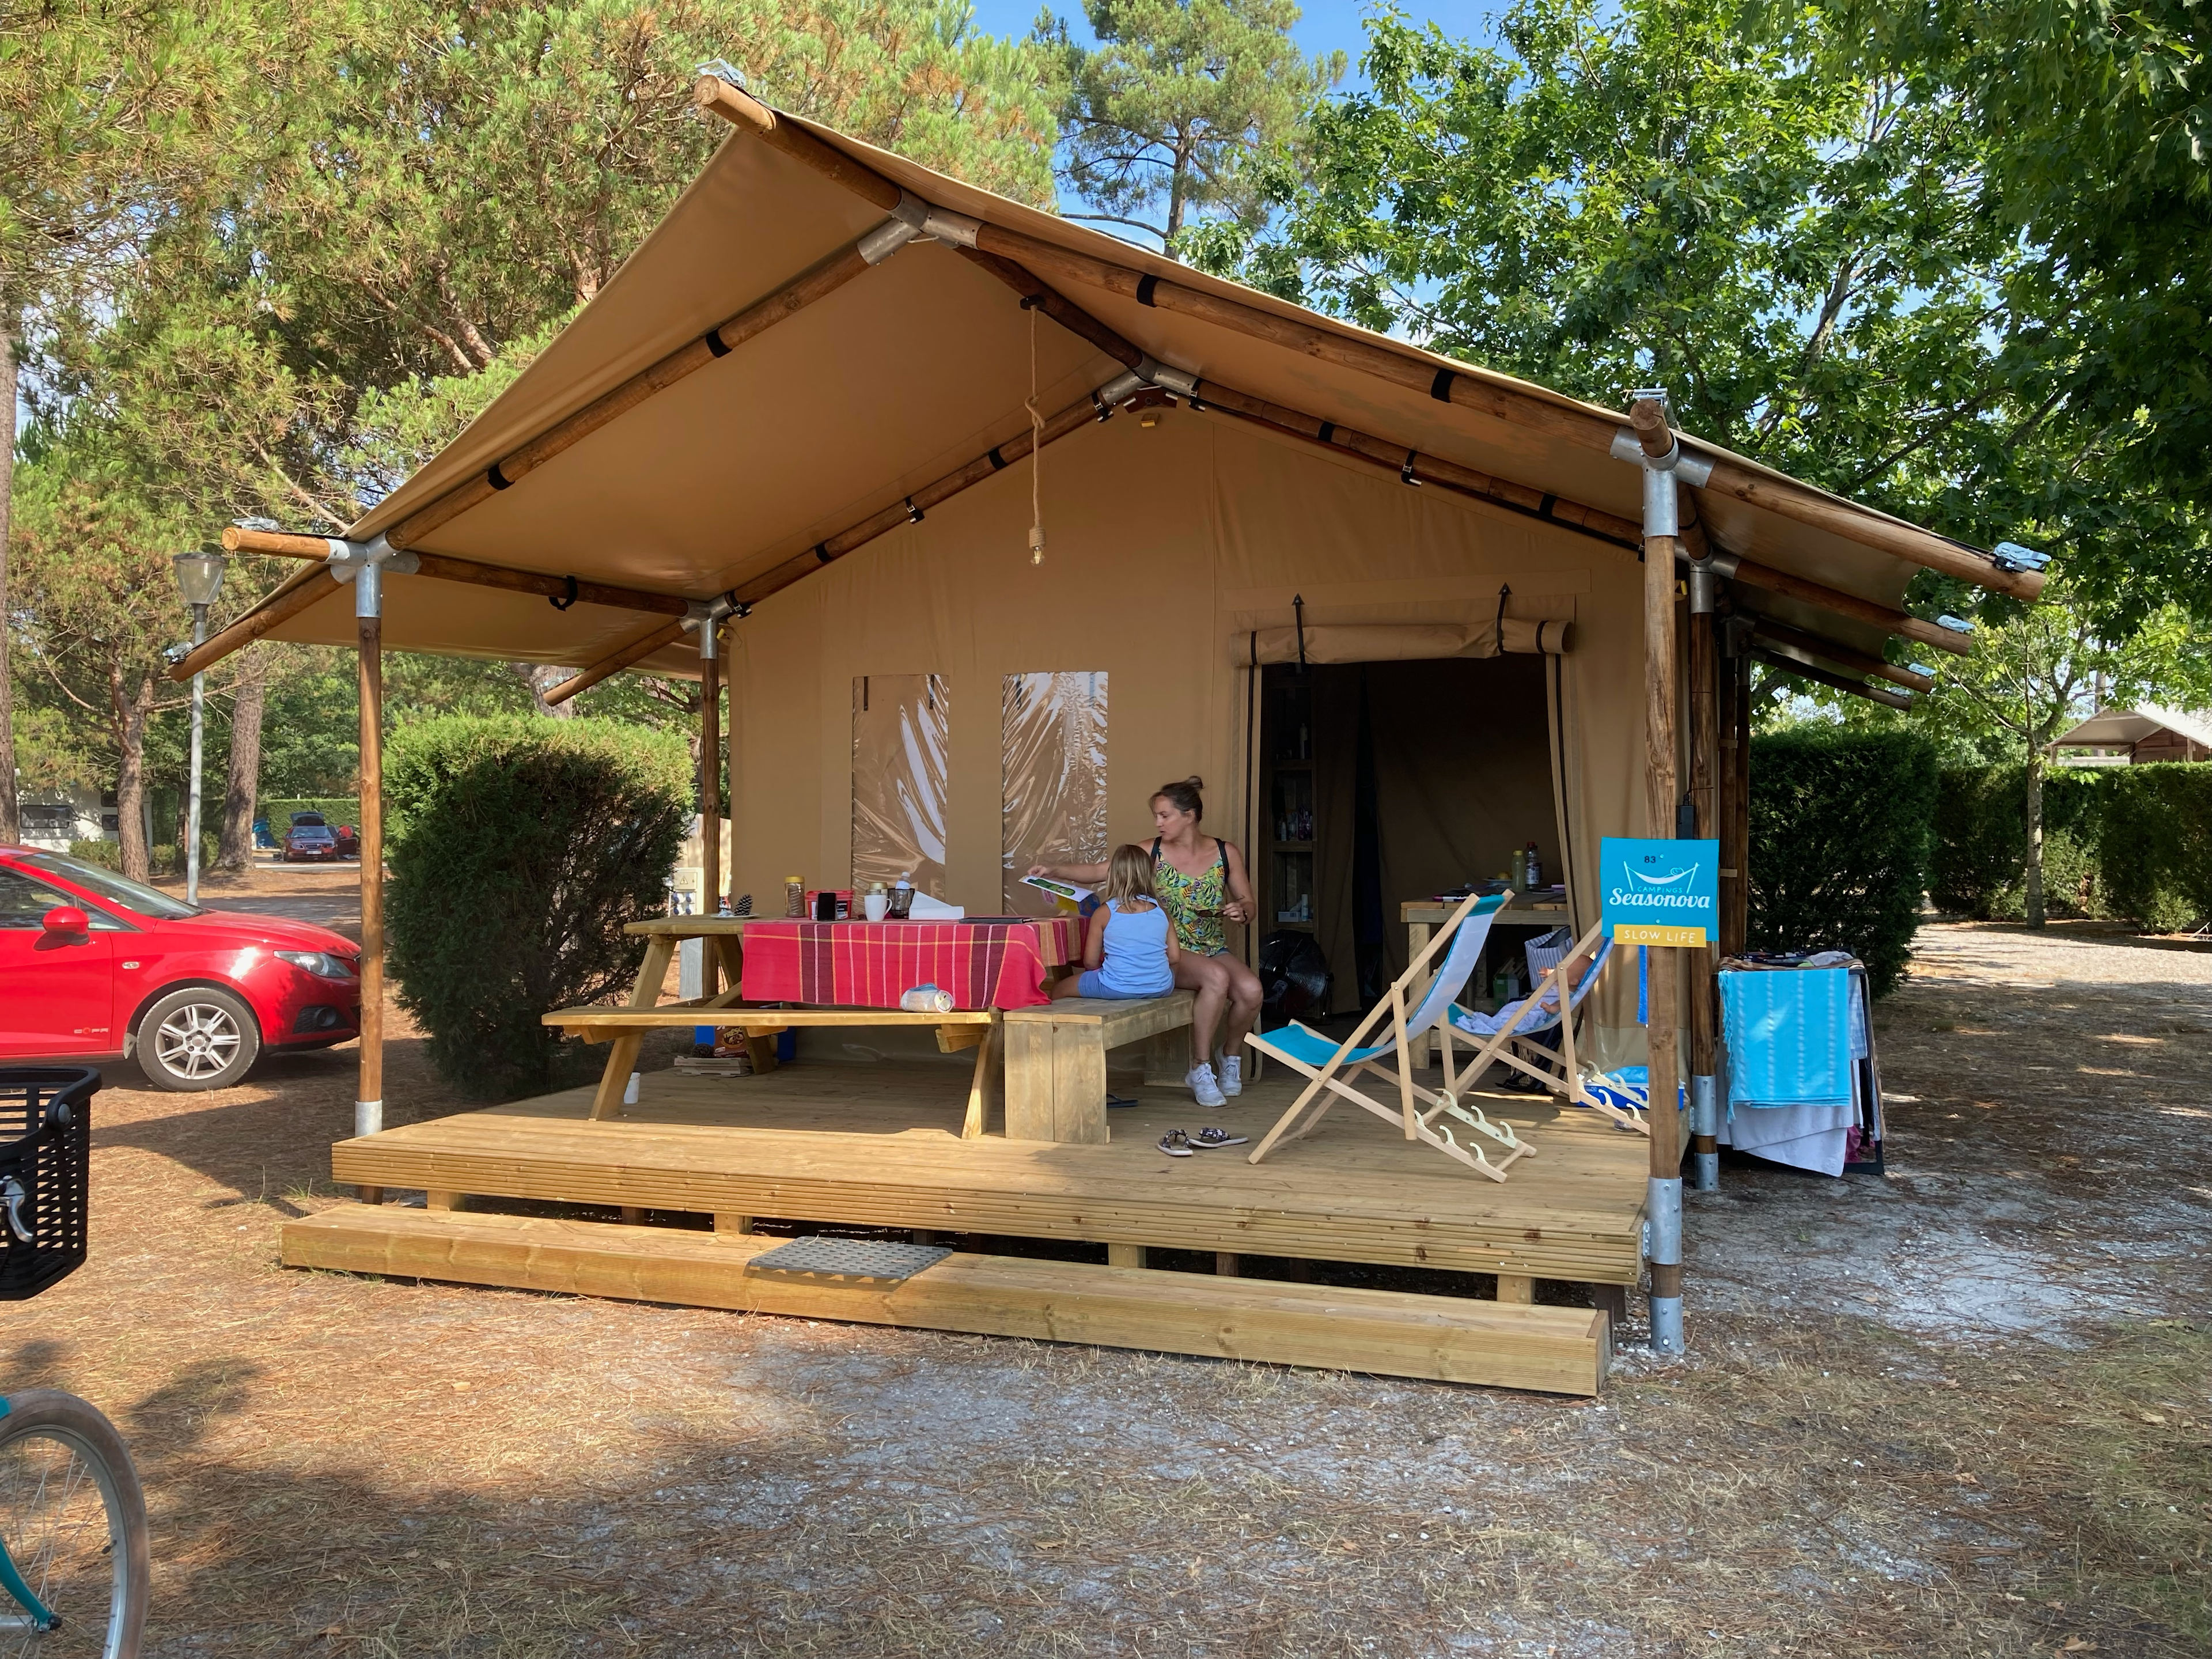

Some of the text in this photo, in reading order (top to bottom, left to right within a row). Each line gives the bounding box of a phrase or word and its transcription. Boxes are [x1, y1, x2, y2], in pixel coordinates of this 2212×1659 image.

[1644, 855, 1656, 863] 83
[1637, 885, 1683, 893] CAMPINGS
[1609, 888, 1710, 908] Seasonova
[1624, 930, 1696, 944] SLOW LIFE
